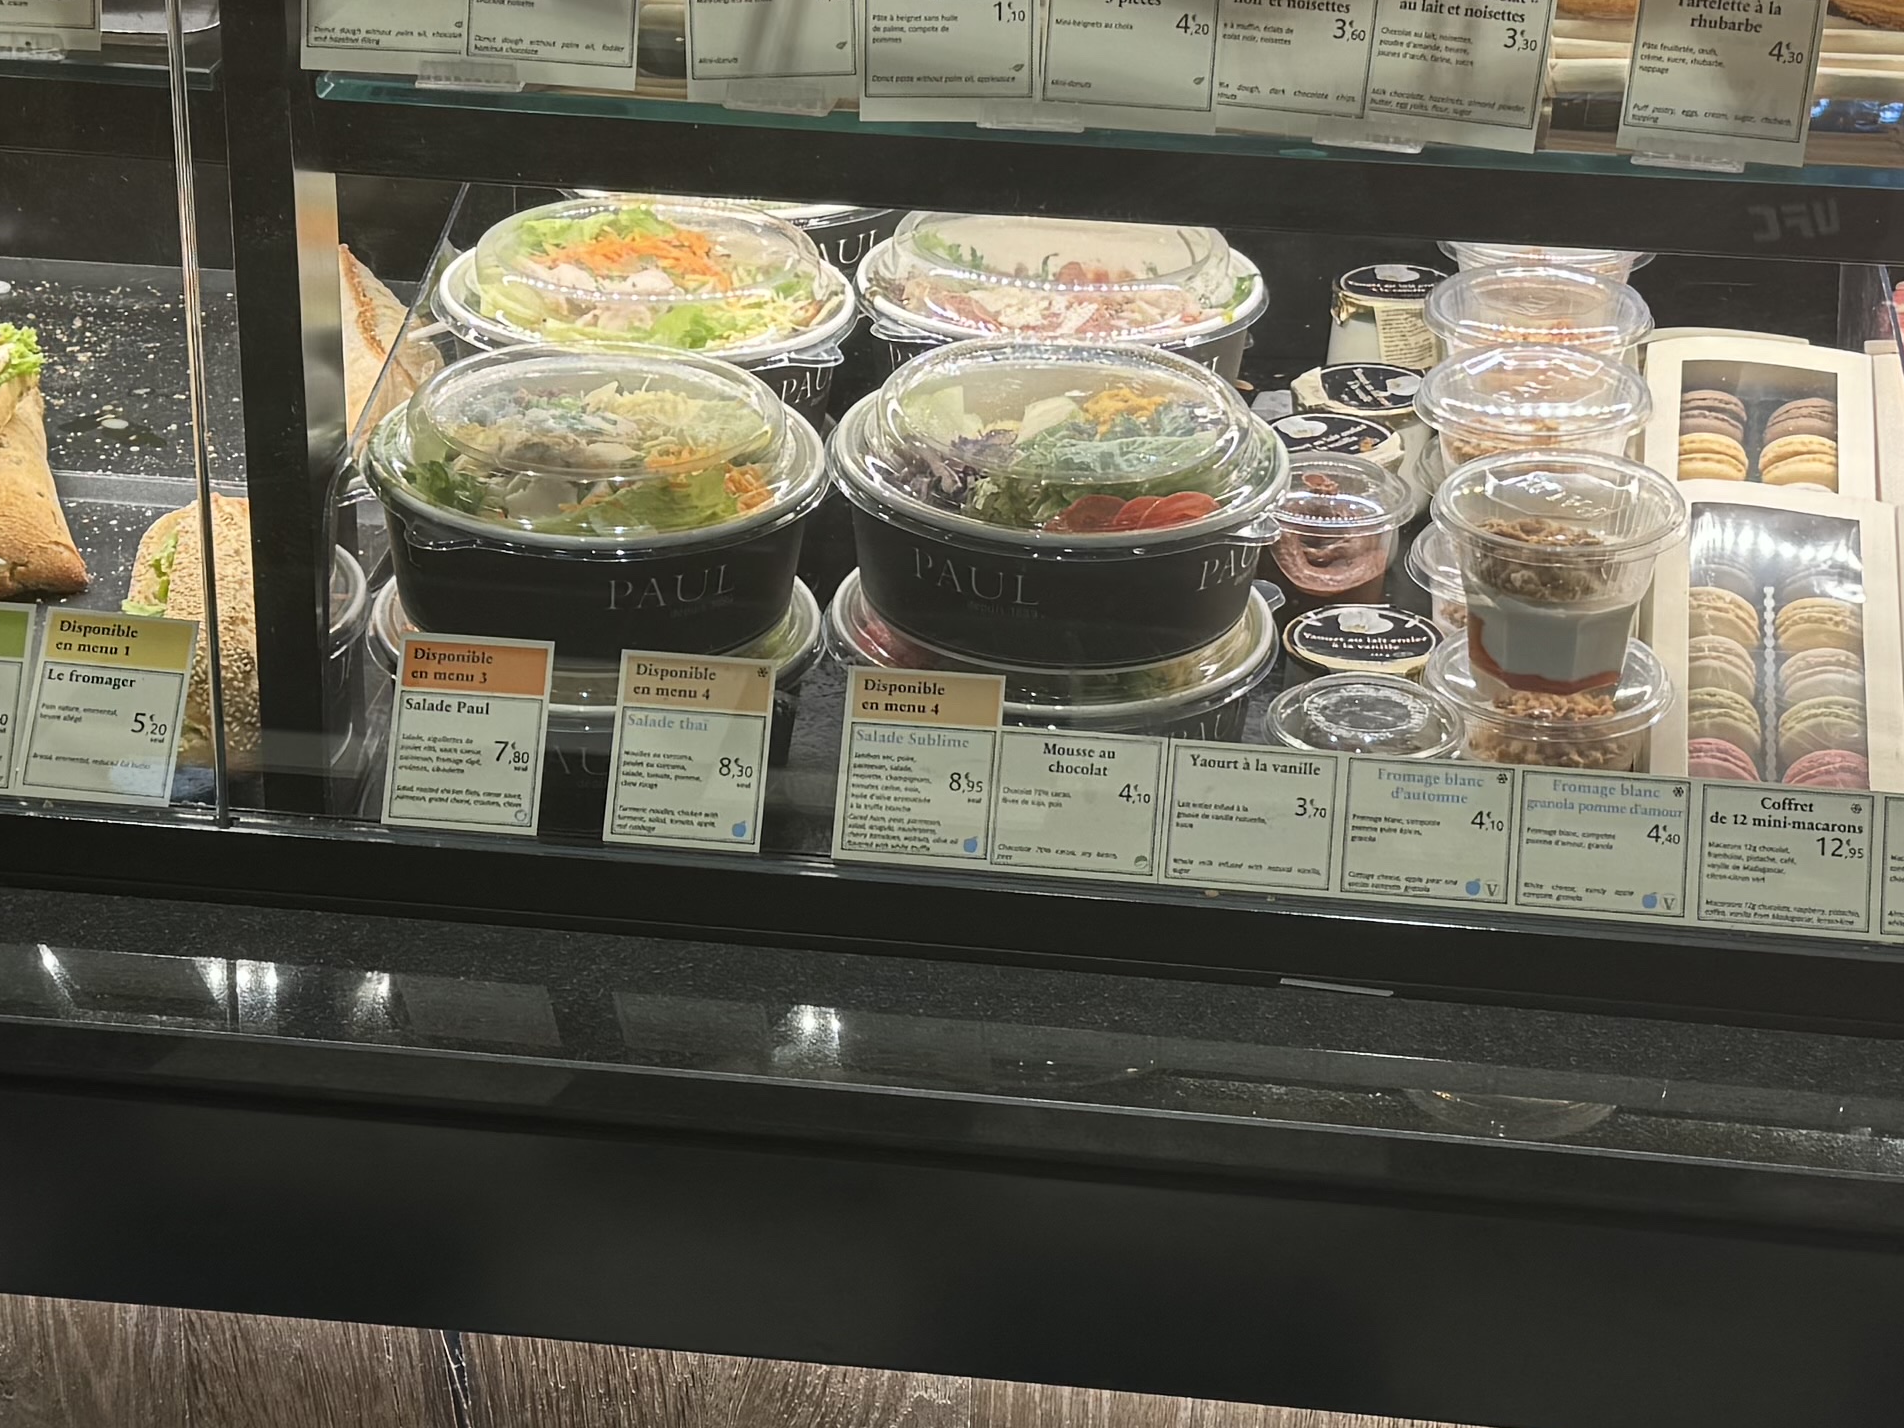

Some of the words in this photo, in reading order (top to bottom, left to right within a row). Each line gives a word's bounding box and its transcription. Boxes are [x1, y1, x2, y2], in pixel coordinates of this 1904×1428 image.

[1446, 3, 1461, 16] et
[1462, 3, 1526, 24] noisettes
[1767, 0, 1782, 16] la
[1689, 13, 1763, 34] rhubarbe
[912, 543, 1040, 606] PAUL
[606, 562, 737, 611] PAUL
[58, 618, 139, 639] Disponible
[54, 640, 73, 651] en
[75, 642, 118, 656] menu
[123, 644, 130, 656] 1
[46, 667, 65, 681] Le
[67, 668, 137, 691] fromager
[403, 696, 452, 713] Salade
[455, 699, 490, 716] Paul
[1042, 741, 1096, 759] Mousse
[1097, 748, 1116, 760] au
[1047, 759, 1108, 777] chocolat
[1189, 752, 1239, 770] Yaourt
[1241, 756, 1251, 771] à
[1254, 757, 1268, 773] la
[1270, 760, 1321, 776] vanille
[1376, 766, 1442, 789] Fromage
[1443, 769, 1485, 788] blanc
[1389, 784, 1471, 805] d'automne
[1759, 795, 1814, 813] Coffret
[1708, 809, 1728, 825] de
[1731, 812, 1748, 826] 12
[1750, 813, 1864, 835] mini-macarons
